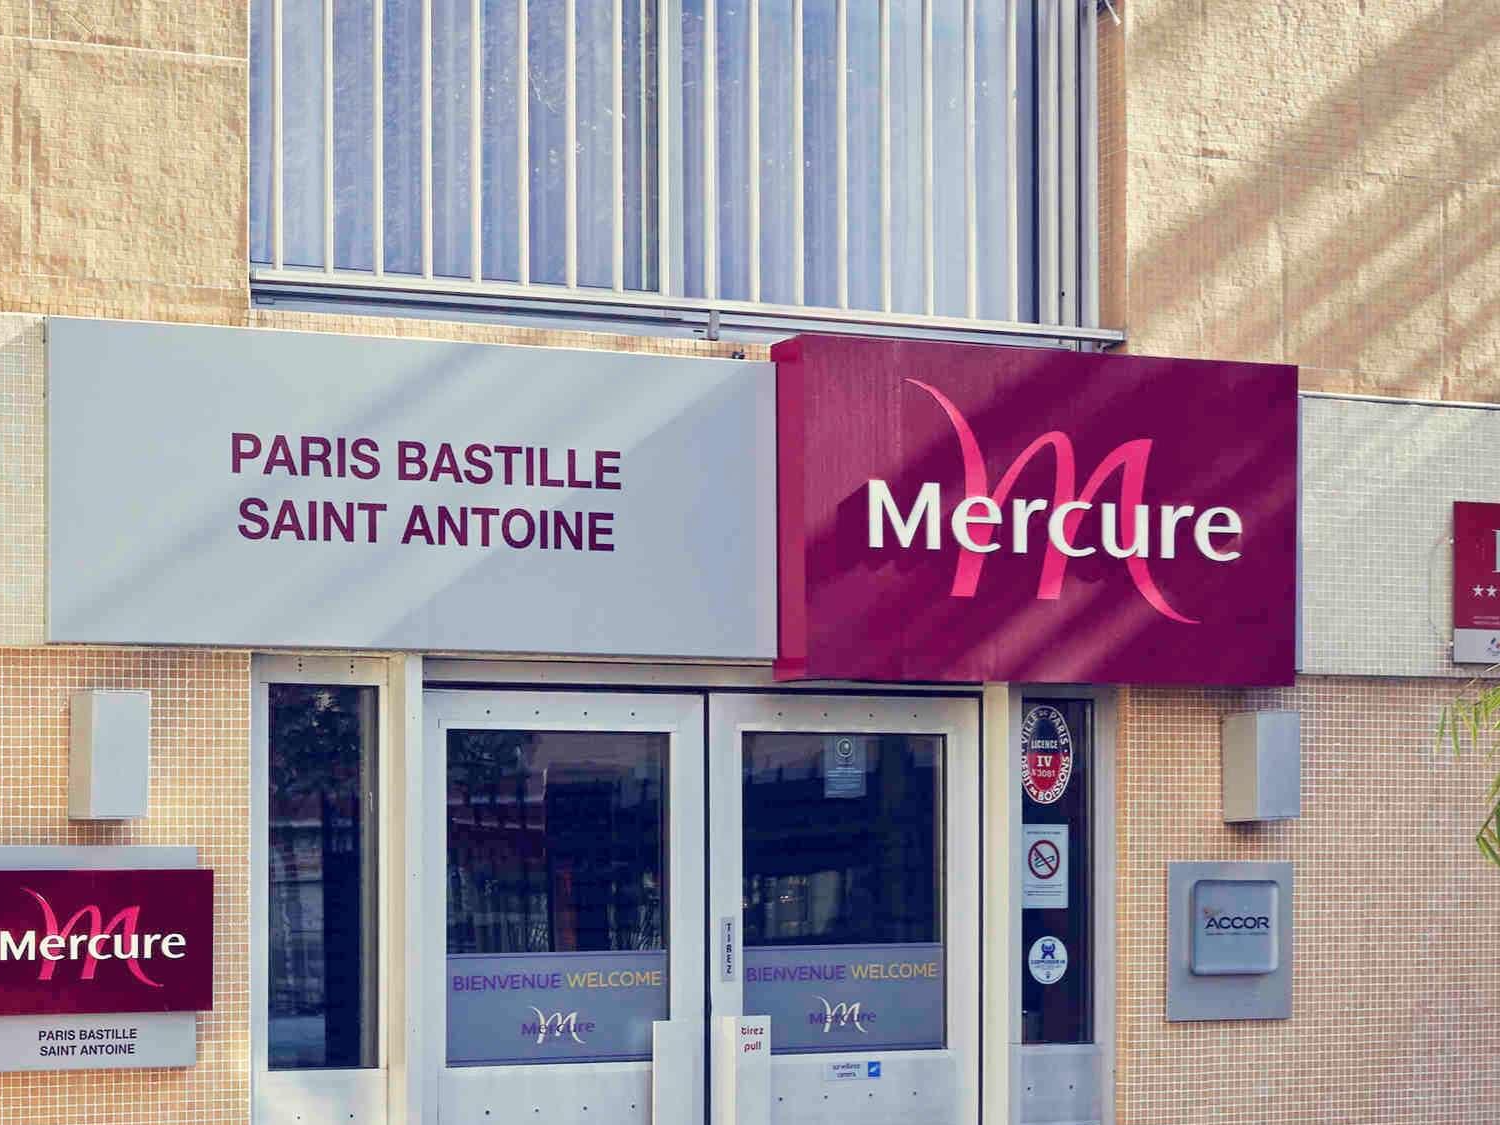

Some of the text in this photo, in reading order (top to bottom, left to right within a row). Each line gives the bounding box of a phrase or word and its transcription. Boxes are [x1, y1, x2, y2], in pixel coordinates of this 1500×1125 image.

[231, 432, 622, 490] PARIS BASTILLE
[237, 497, 616, 552] SAINT ANTOINE
[867, 478, 1244, 562] Mercure
[1048, 711, 1069, 745] PARIS
[1036, 755, 1053, 767] IV
[1038, 755, 1070, 801] BOISSONS
[1203, 916, 1270, 929] ACCOR
[0, 930, 187, 962] Mercure
[452, 971, 662, 991] BIENVENUE WELCOME
[746, 962, 939, 982] BIENVENUE WELCOME
[38, 1028, 138, 1041] PARIS BASTILLE
[741, 1026, 764, 1035] tirez
[40, 1043, 136, 1056] SAINT ANTOINE
[744, 1040, 762, 1053] pull
